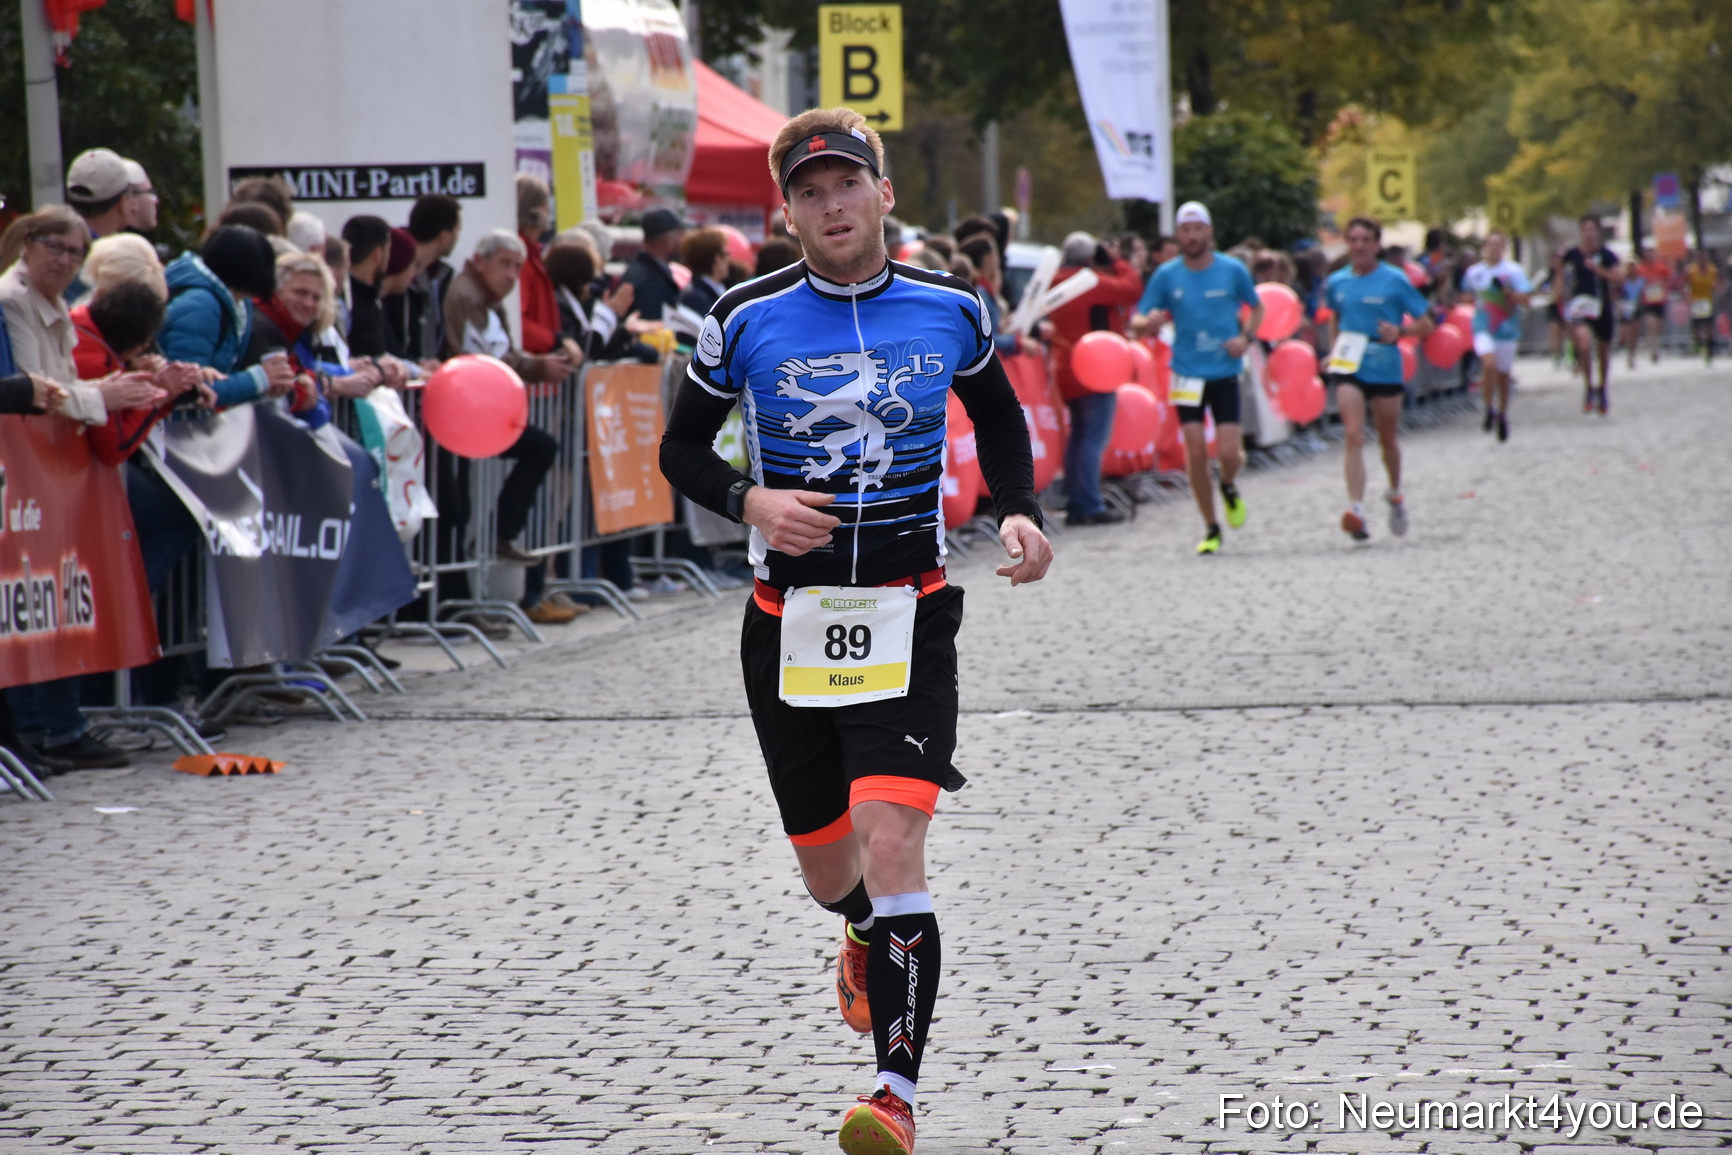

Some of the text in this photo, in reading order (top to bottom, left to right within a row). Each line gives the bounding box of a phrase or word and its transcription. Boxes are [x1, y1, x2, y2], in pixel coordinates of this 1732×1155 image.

[830, 12, 892, 33] Block
[843, 46, 881, 102] B
[231, 167, 477, 199] MINI-Partl.de
[1379, 170, 1402, 203] C
[908, 353, 944, 377] 15
[868, 472, 902, 480] TRIATHLON
[834, 599, 877, 608] BOCK
[825, 624, 871, 660] 89
[829, 674, 864, 686] Klaus
[906, 952, 919, 1040] JOLSPORT
